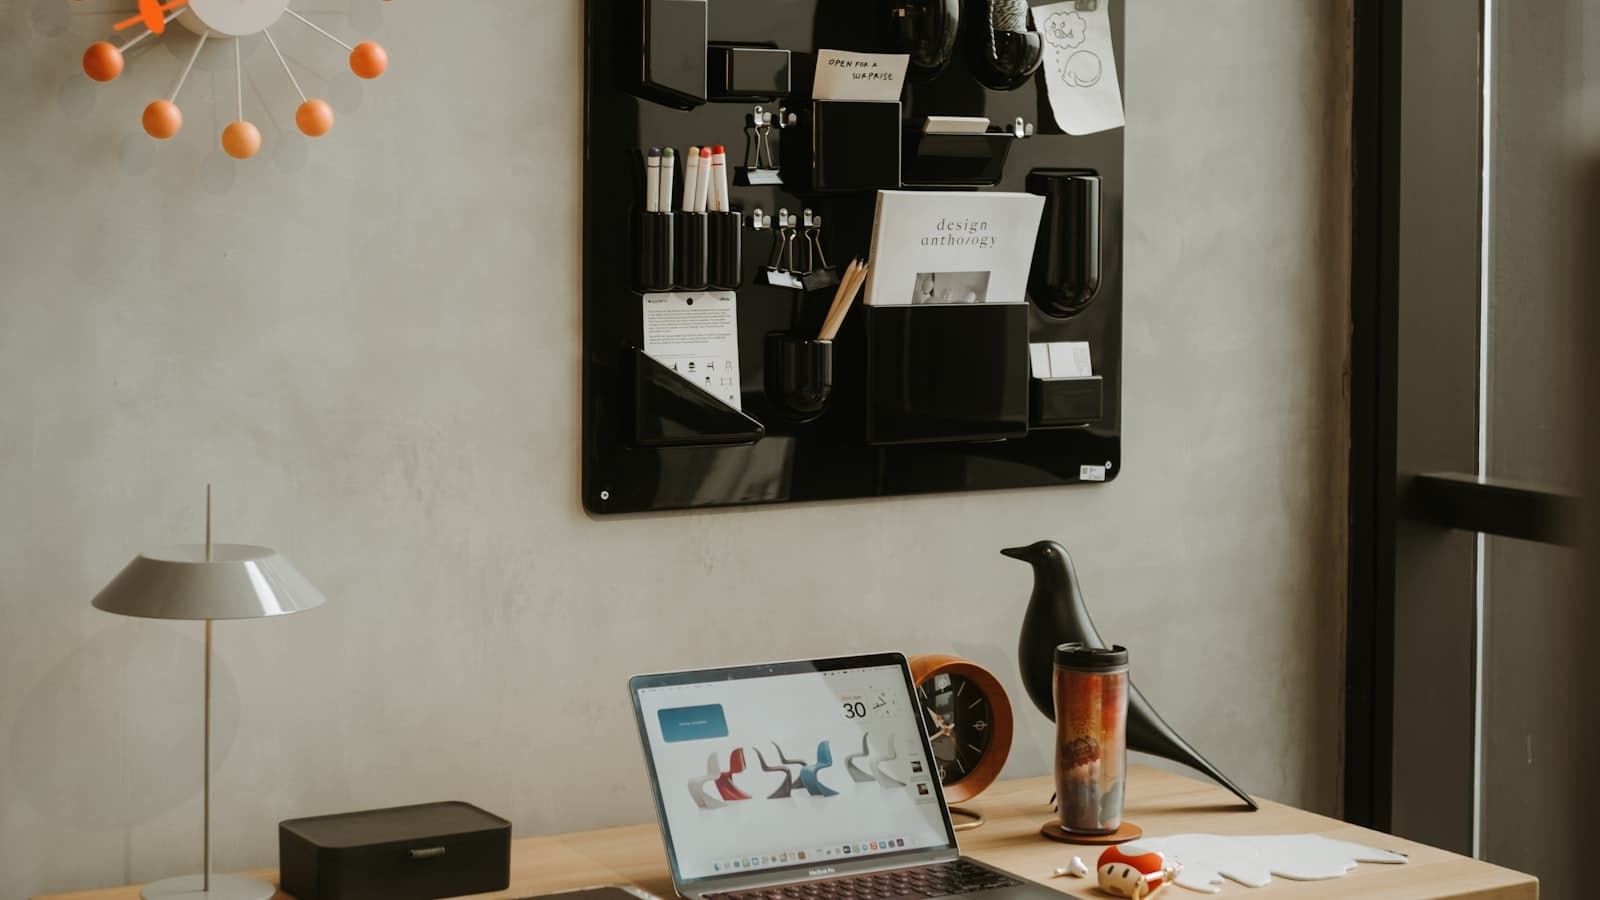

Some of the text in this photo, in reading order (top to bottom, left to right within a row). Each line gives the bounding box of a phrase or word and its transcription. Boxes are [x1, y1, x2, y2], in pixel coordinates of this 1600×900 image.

[828, 59, 852, 68] OPEN
[852, 72, 894, 80] SURPRISE
[936, 218, 988, 234] design
[920, 233, 996, 248] anthology
[843, 702, 866, 718] 30
